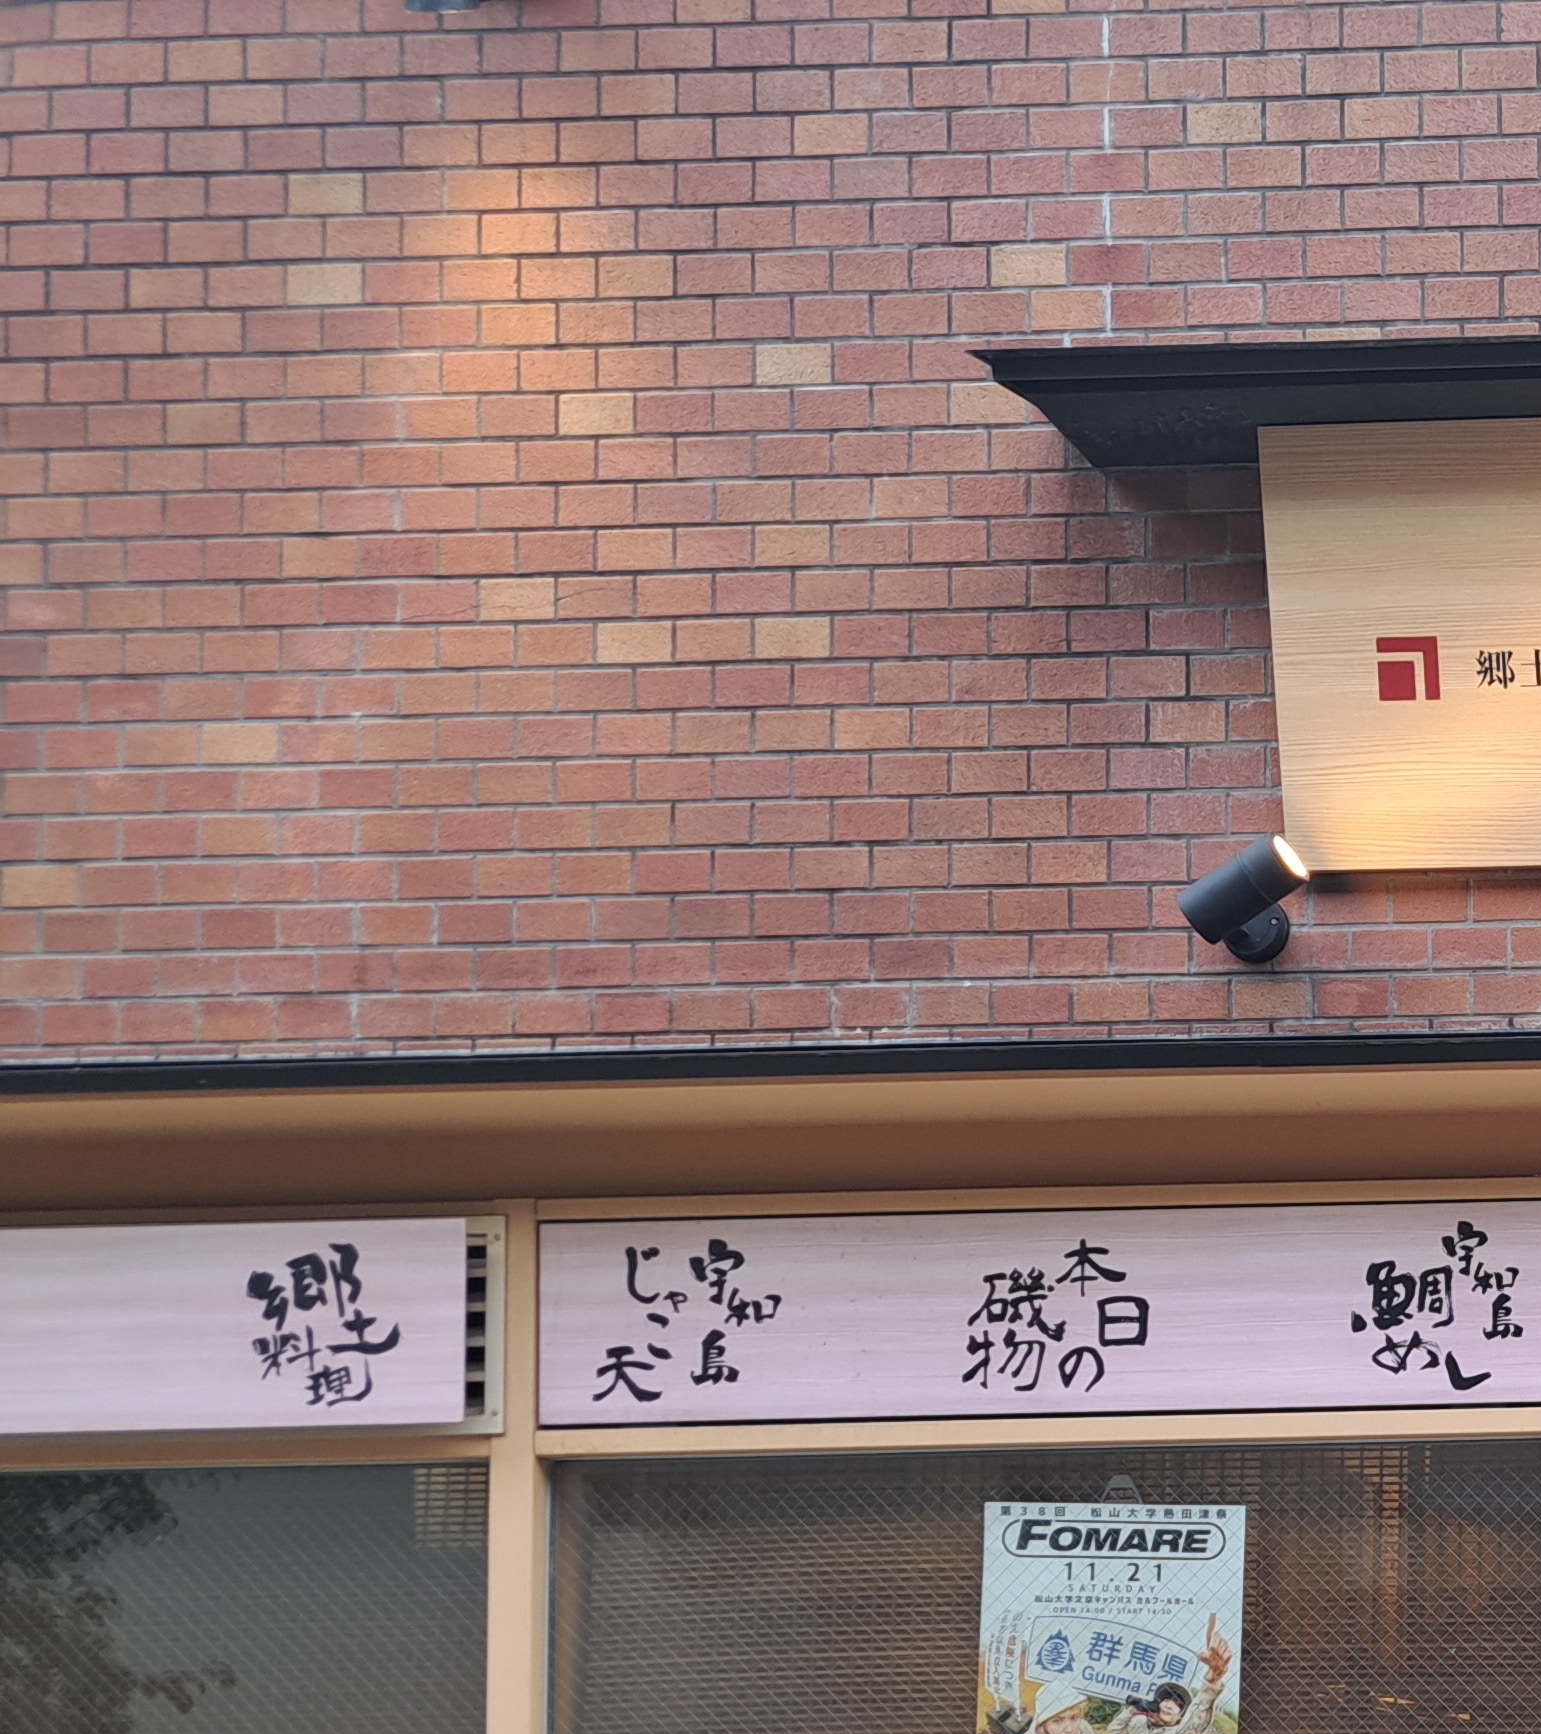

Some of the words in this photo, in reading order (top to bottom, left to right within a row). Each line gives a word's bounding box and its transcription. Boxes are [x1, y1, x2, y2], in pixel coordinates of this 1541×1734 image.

[247, 1242, 400, 1406] 郷土料理
[592, 1246, 688, 1402] じゃこ天
[690, 1238, 781, 1386] 宇和島
[961, 1273, 1066, 1392] 磯物
[1055, 1239, 1149, 1392] 本日の
[1351, 1262, 1491, 1391] 鯛めし
[1441, 1220, 1523, 1341] 宇和島
[1016, 1519, 1211, 1553] FOMARE
[1067, 1584, 1156, 1593] SATURDAY
[1081, 1665, 1141, 1694] Gunma
[1086, 1630, 1189, 1682] 群馬県
